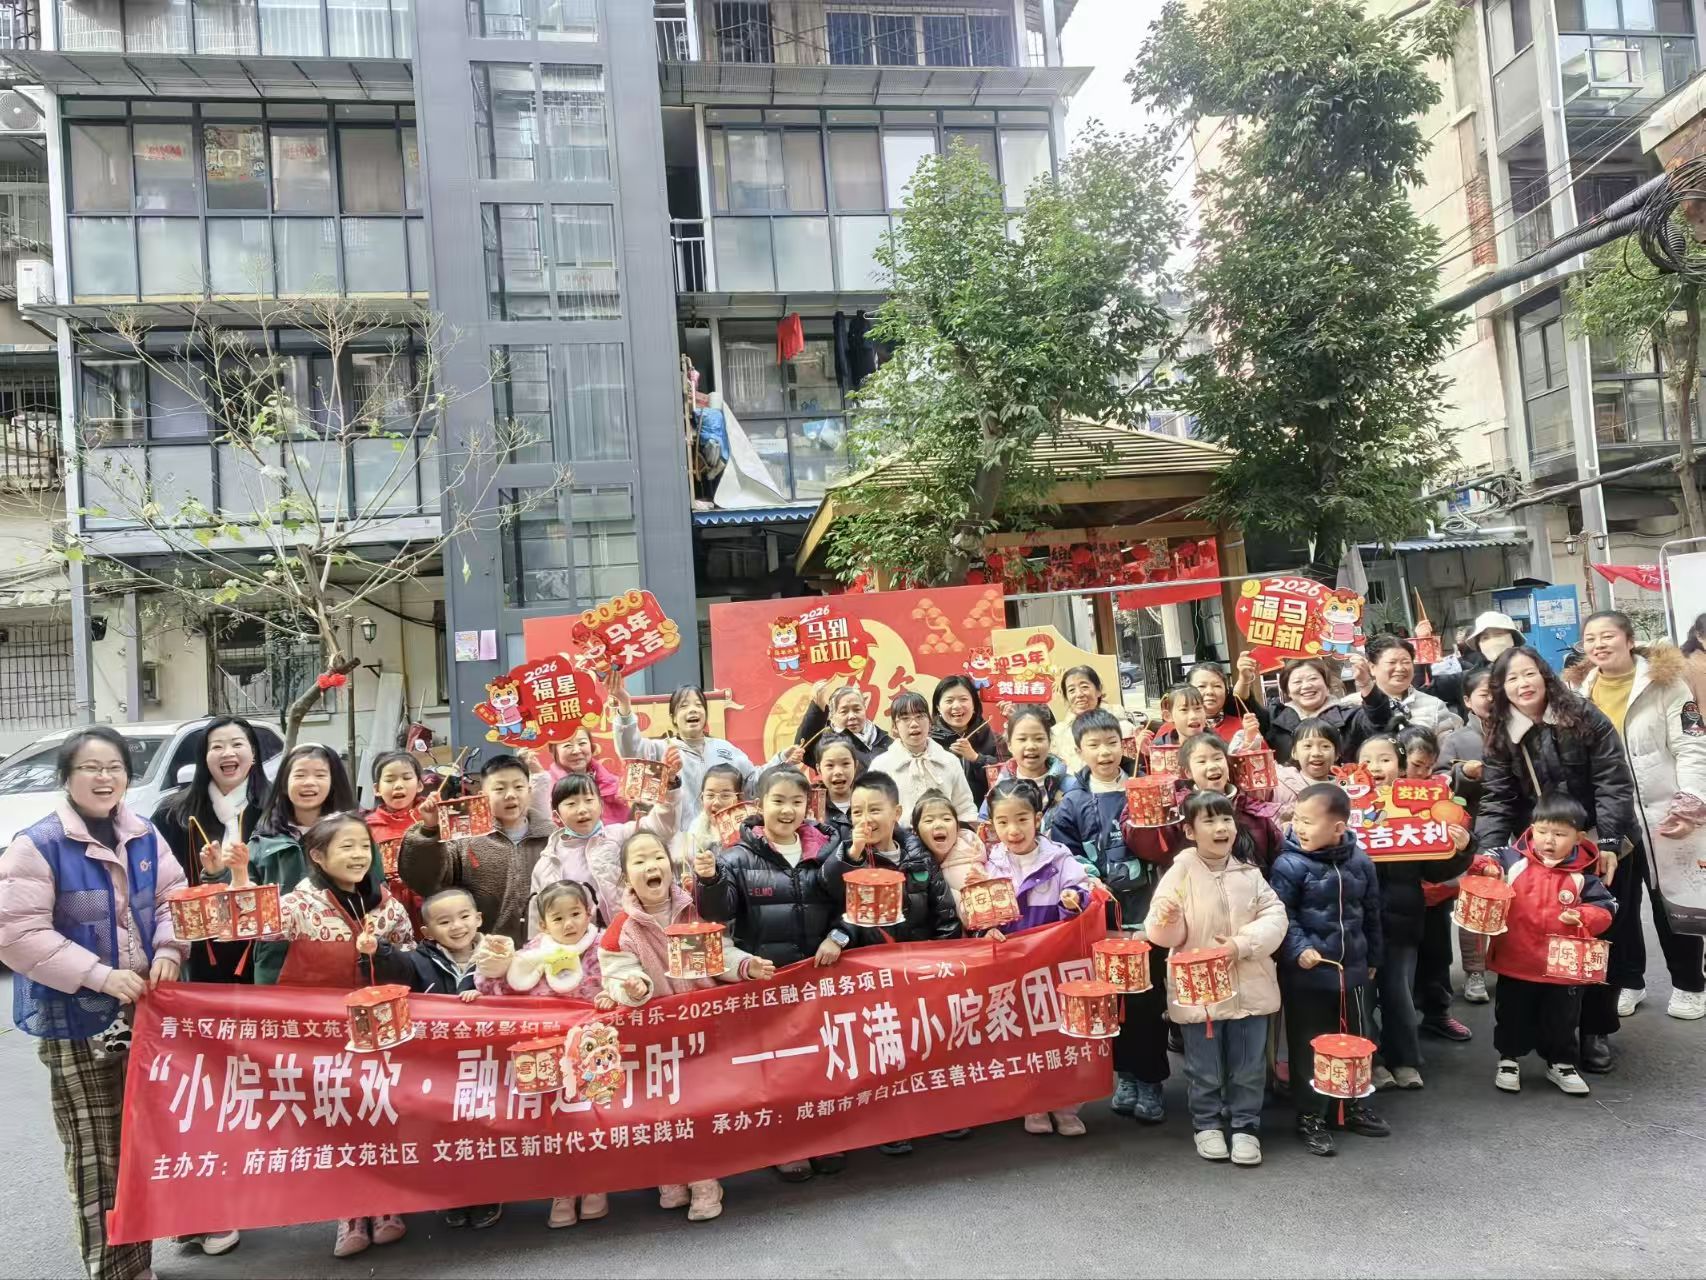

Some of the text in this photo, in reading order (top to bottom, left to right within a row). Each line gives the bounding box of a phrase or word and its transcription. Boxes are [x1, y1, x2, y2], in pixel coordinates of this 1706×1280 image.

[1264, 578, 1321, 598] 2026
[585, 592, 642, 627] 2026
[799, 604, 830, 626] 2026
[1251, 595, 1308, 626] 福马
[605, 610, 652, 645] 马年
[806, 618, 848, 640] 马到
[1247, 620, 1304, 651] 迎新
[620, 631, 665, 665] 大吉
[810, 641, 852, 664] 成功
[523, 660, 558, 684] 2026
[993, 650, 1045, 672] 迎马年
[532, 675, 578, 702] 福星
[997, 681, 1047, 696] 贺新春
[536, 698, 584, 726] 高照
[1397, 785, 1444, 801] 发达了
[432, 1119, 695, 1163] 文苑社区新时代文明实践站
